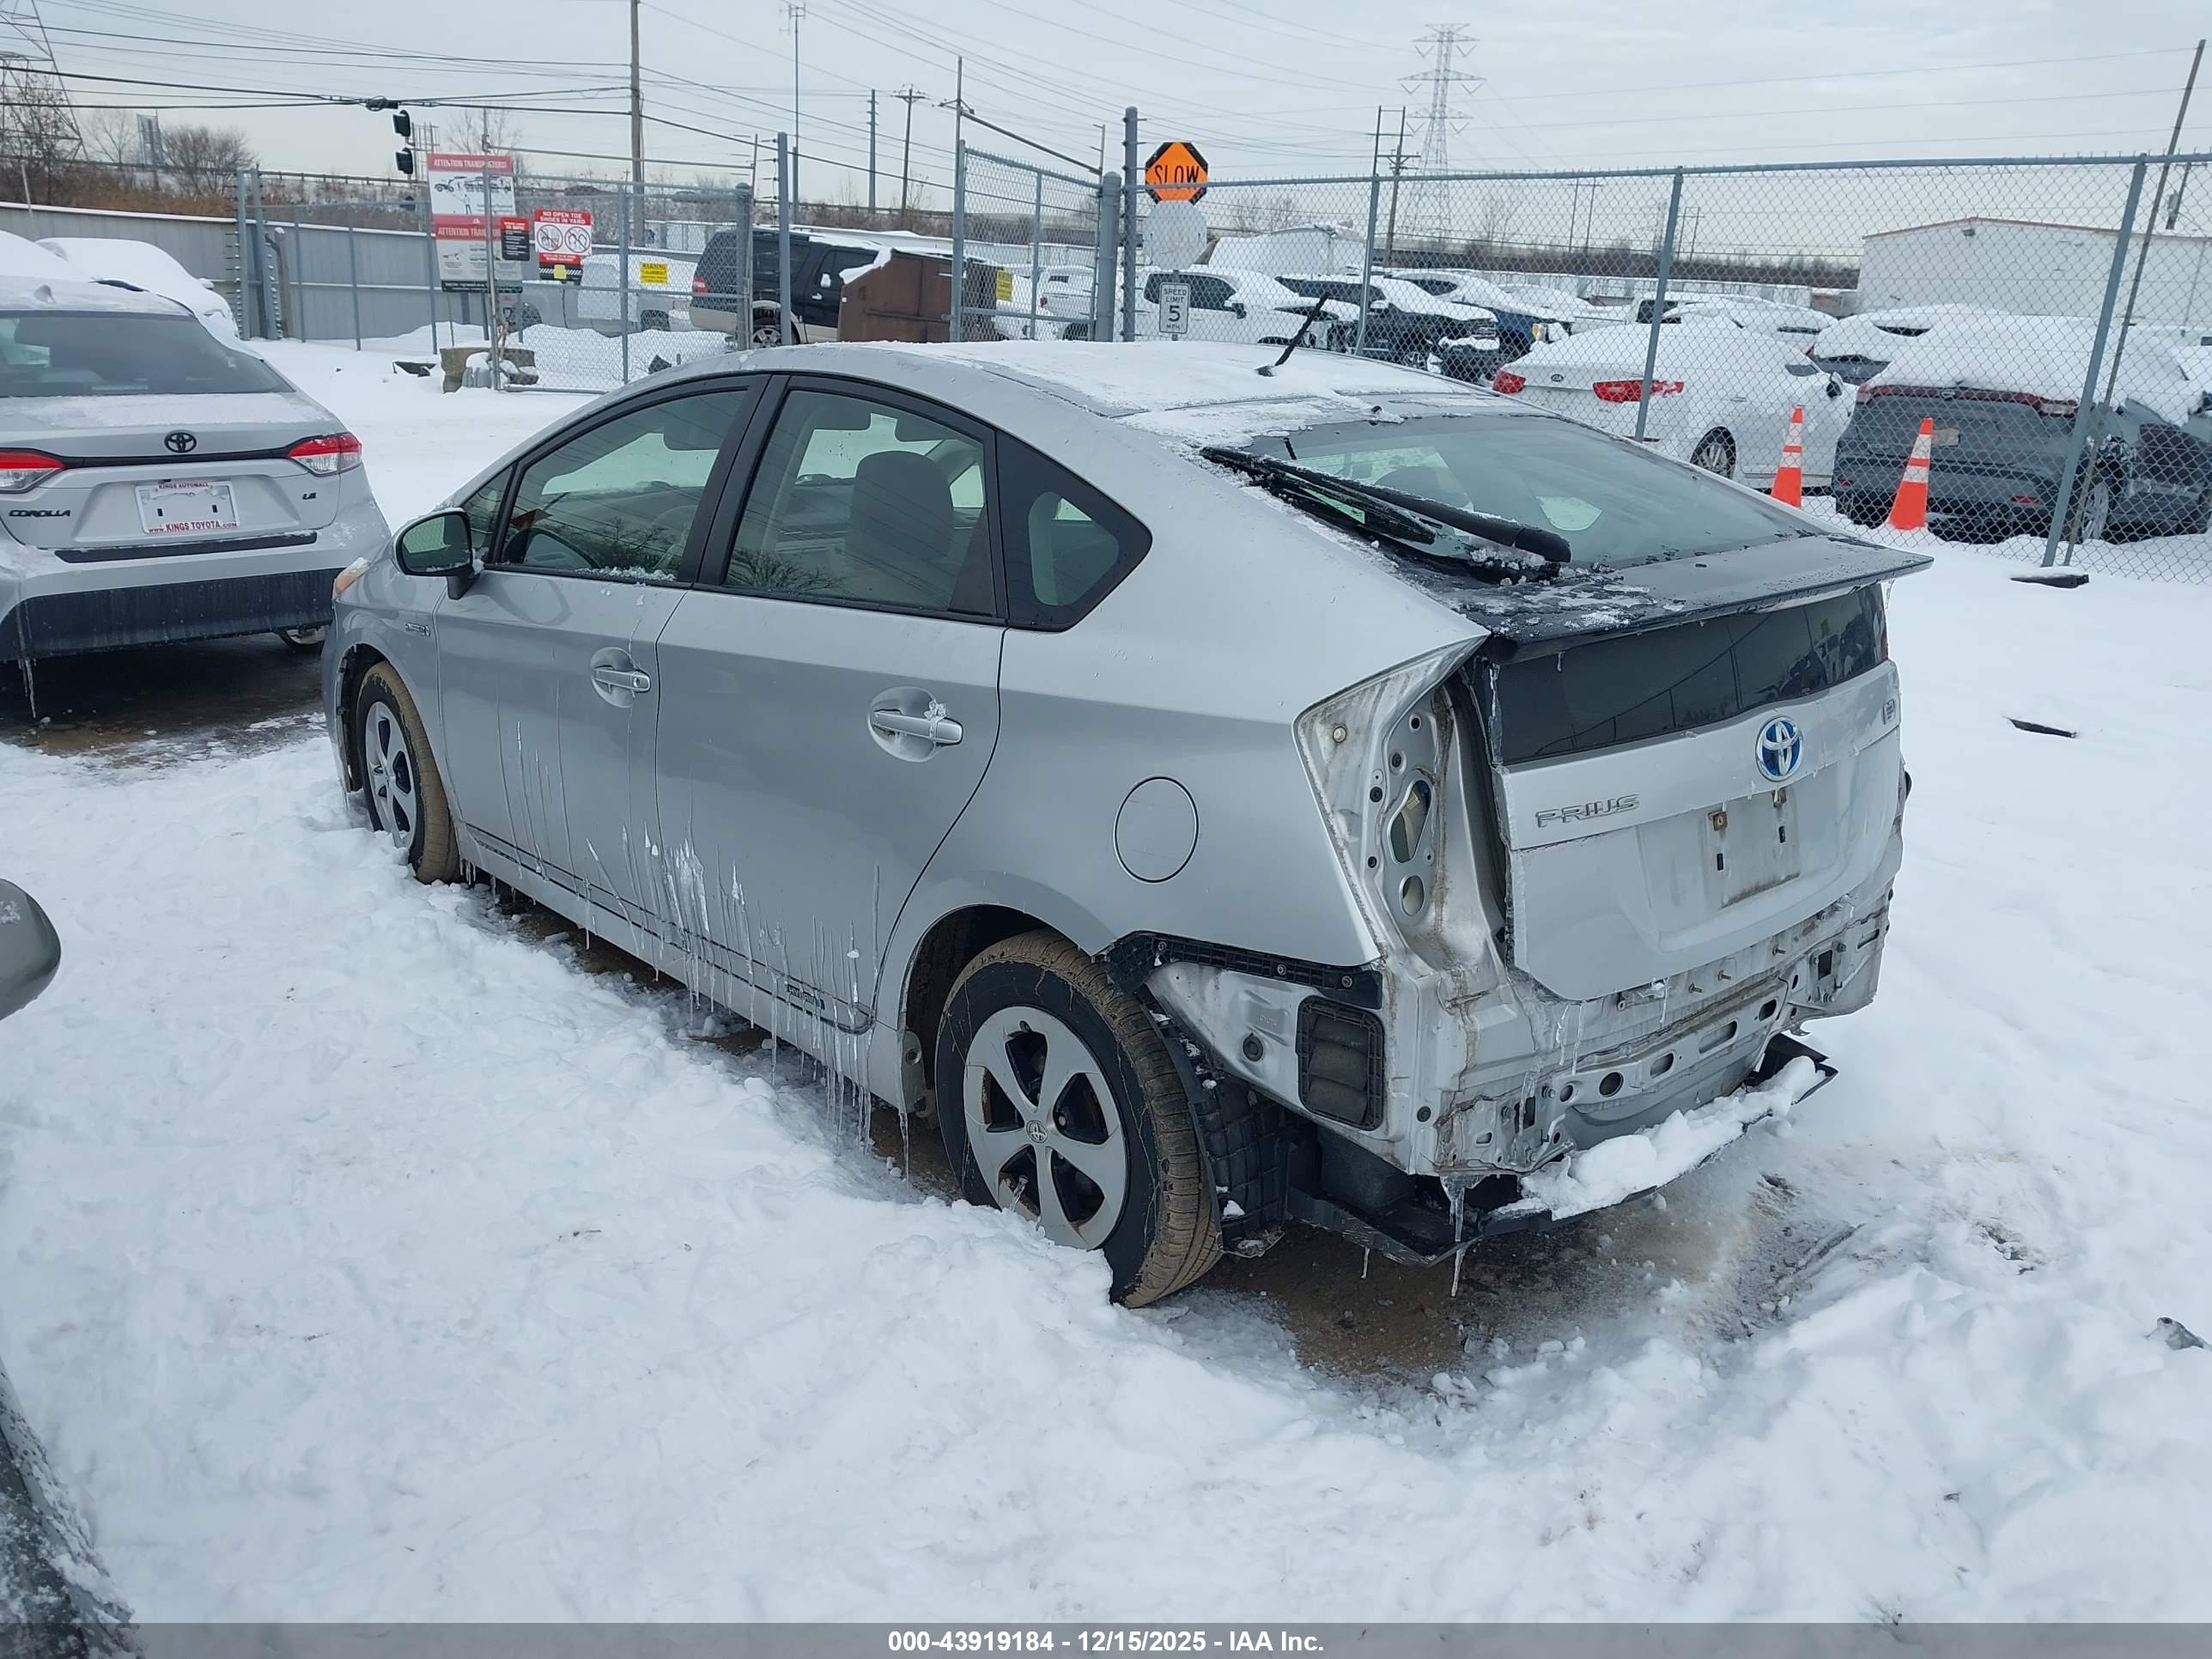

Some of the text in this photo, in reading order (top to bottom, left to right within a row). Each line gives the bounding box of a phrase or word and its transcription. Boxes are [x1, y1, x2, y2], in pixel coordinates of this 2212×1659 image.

[1154, 165, 1200, 190] SLOW
[438, 227, 469, 236] ATTENTION
[1169, 305, 1181, 322] 5
[1535, 794, 1639, 828] PRIUS
